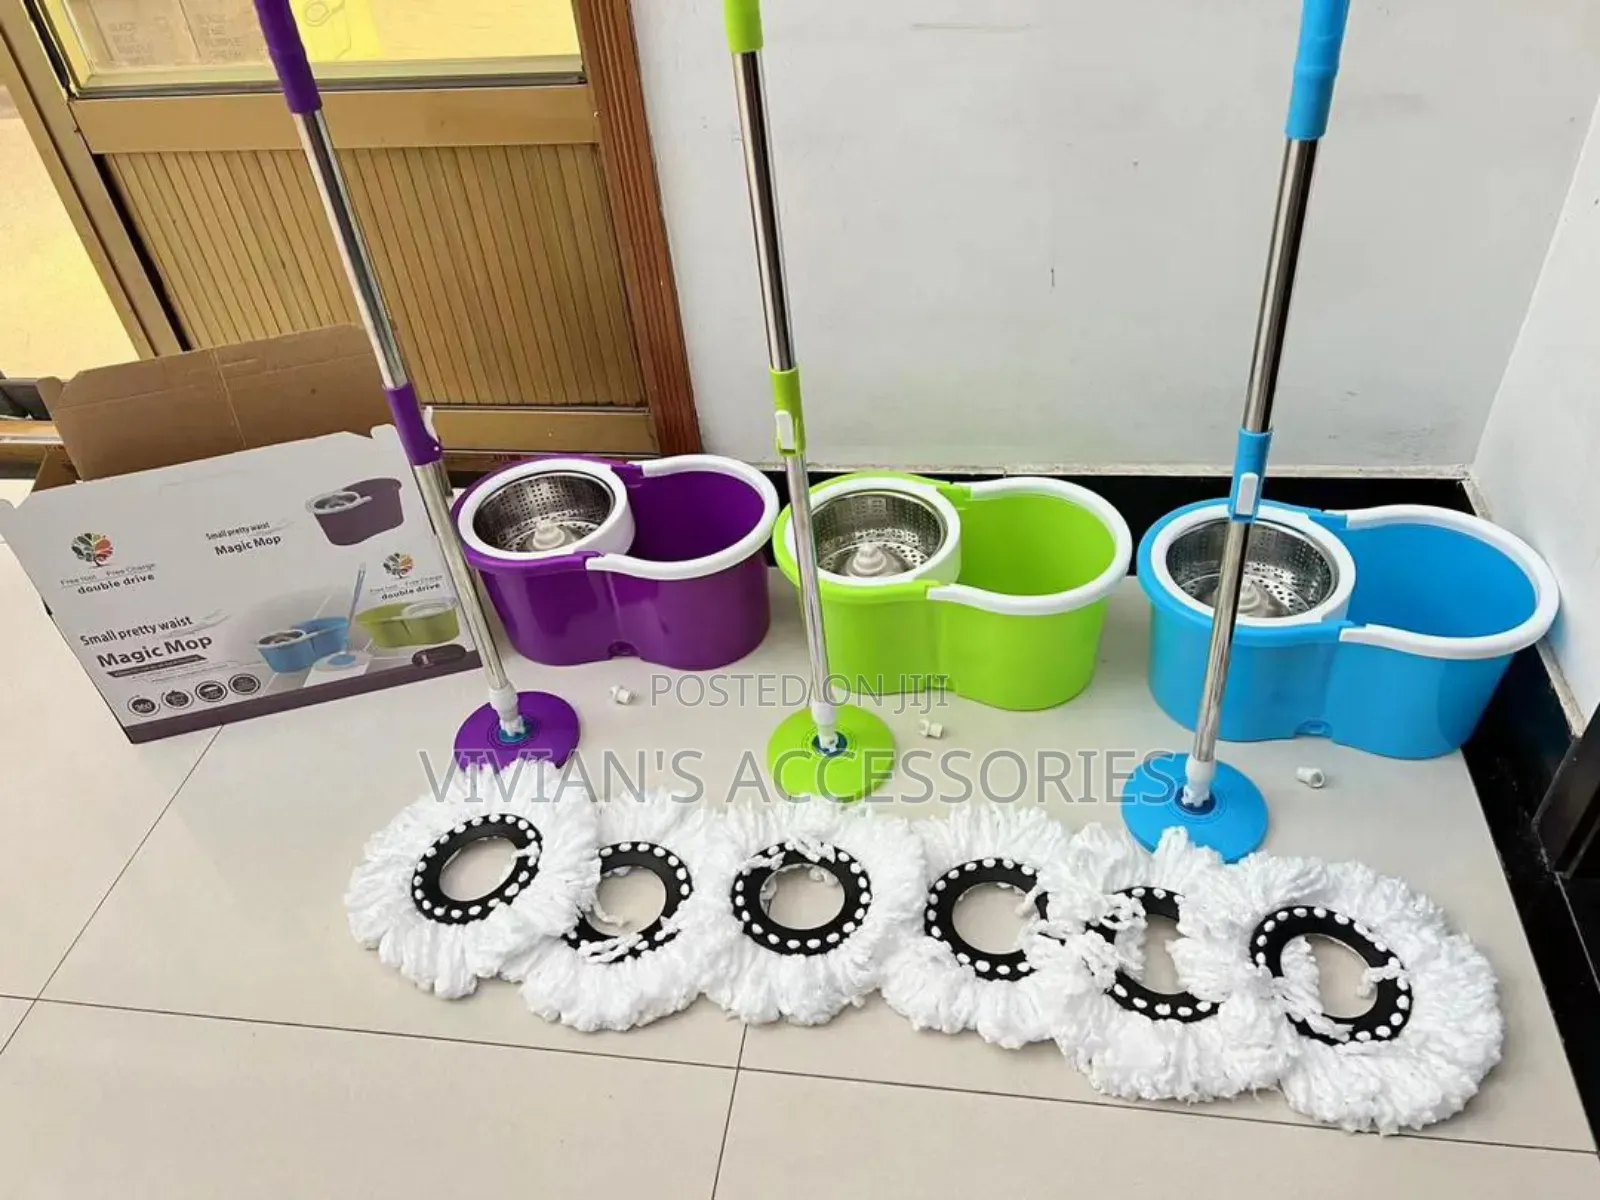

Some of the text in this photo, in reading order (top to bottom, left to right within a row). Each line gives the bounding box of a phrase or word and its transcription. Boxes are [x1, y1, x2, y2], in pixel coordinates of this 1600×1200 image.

[206, 529, 226, 540] Small
[227, 526, 250, 538] pretty
[214, 535, 281, 556] Magic Mop
[77, 574, 155, 595] double drive
[381, 582, 440, 600] double drive
[80, 615, 193, 647] Small pretty waist
[96, 644, 164, 668] Magic
[163, 636, 213, 656] Mop
